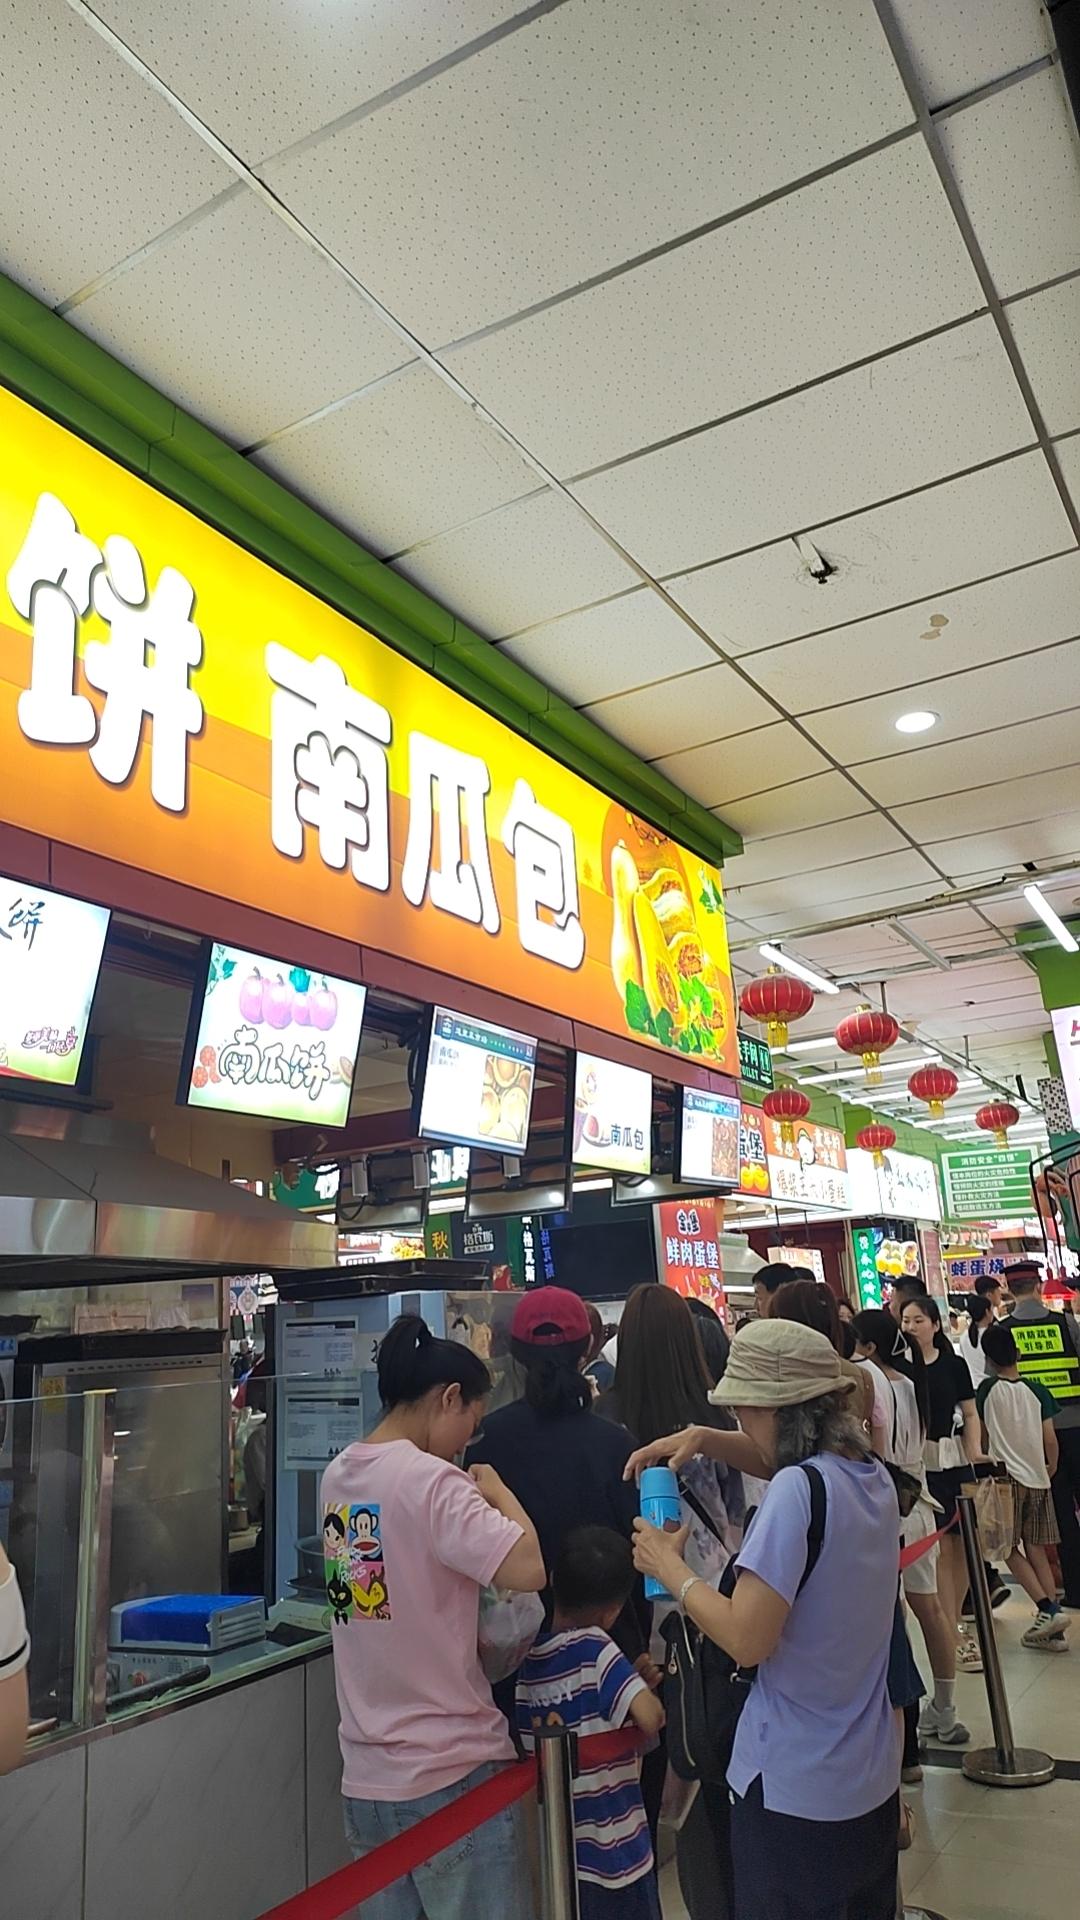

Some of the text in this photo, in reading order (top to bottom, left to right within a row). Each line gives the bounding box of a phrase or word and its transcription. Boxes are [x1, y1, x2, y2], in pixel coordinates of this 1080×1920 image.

[8, 492, 585, 970] 饼 南瓜包
[218, 1024, 331, 1101] 南瓜饼
[610, 1123, 644, 1151] 南瓜包
[665, 1236, 720, 1270] 鲜肉蛋堡
[1016, 1328, 1057, 1340] 消防疏散
[1024, 1340, 1054, 1351] 引导员
